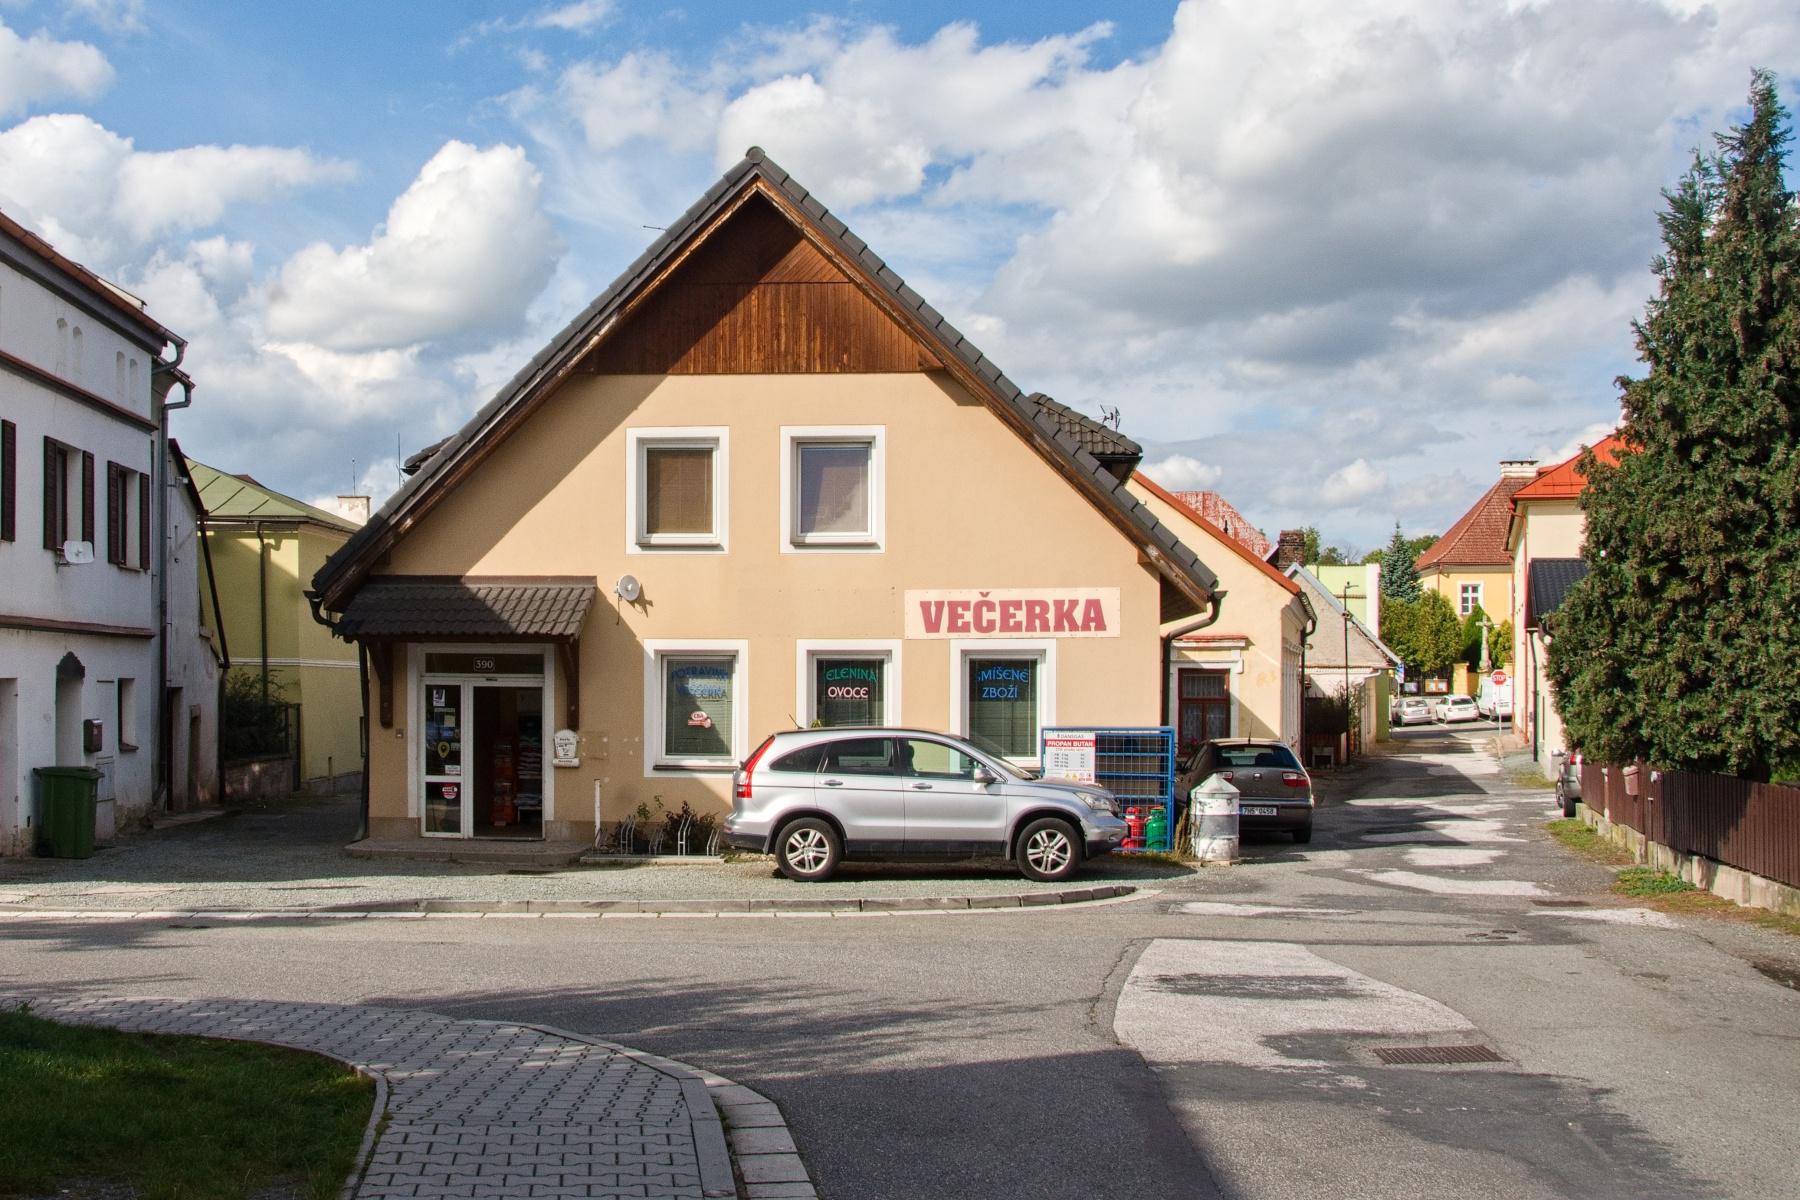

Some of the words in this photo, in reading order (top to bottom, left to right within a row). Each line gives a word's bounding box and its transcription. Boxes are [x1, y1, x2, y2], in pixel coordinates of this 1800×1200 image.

[919, 591, 1107, 633] VEČERKA
[828, 687, 869, 699] OVOCE
[982, 684, 1018, 698] ZBOŽÍ
